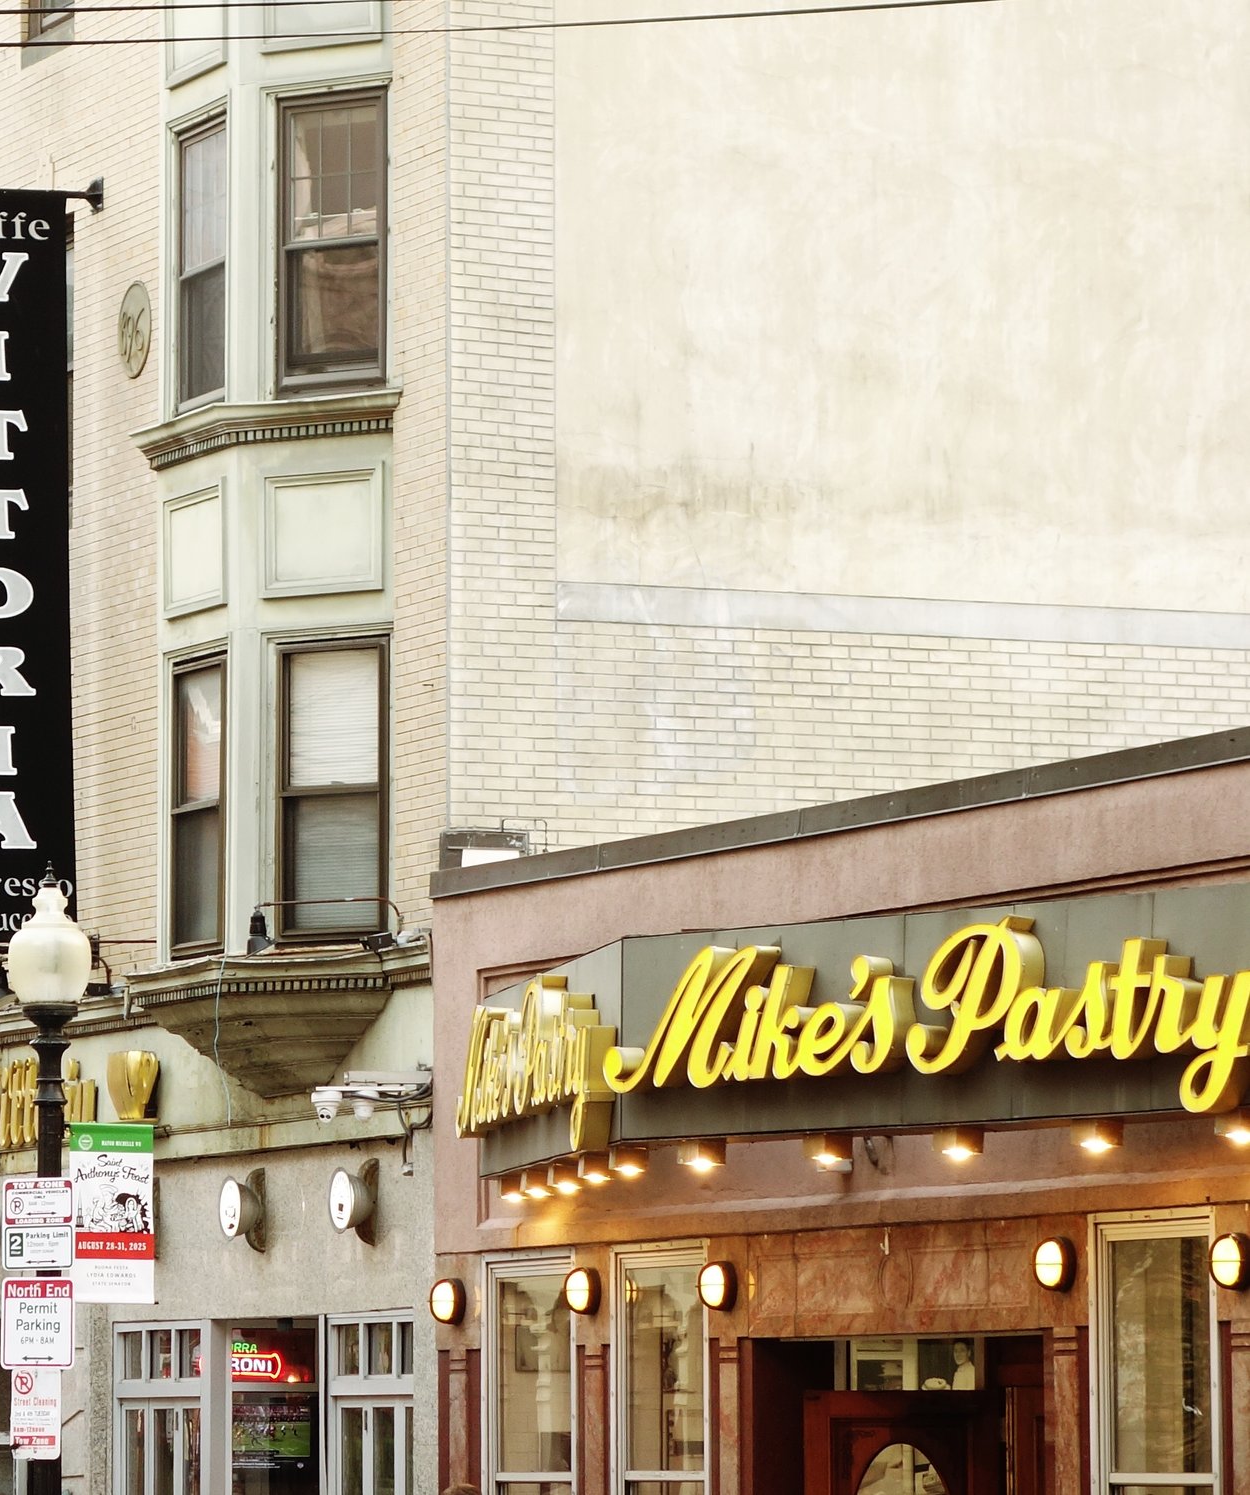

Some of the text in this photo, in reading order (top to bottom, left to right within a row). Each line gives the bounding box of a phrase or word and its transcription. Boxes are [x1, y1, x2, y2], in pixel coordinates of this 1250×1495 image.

[602, 915, 1250, 1113] Mike's Pastry
[12, 1180, 66, 1190] TOW ZONE
[25, 1231, 69, 1240] Parking Limit
[10, 1235, 22, 1250] 2
[77, 1241, 147, 1252] AUGUST 28-31, 2025
[7, 1283, 70, 1298] North End
[19, 1301, 58, 1314] Permit
[15, 1318, 61, 1334] Parking
[20, 1336, 35, 1345] 6PM
[40, 1336, 55, 1345] 8AM
[13, 1397, 57, 1408] Street Cleaning
[14, 1436, 50, 1445] Tow Zone
